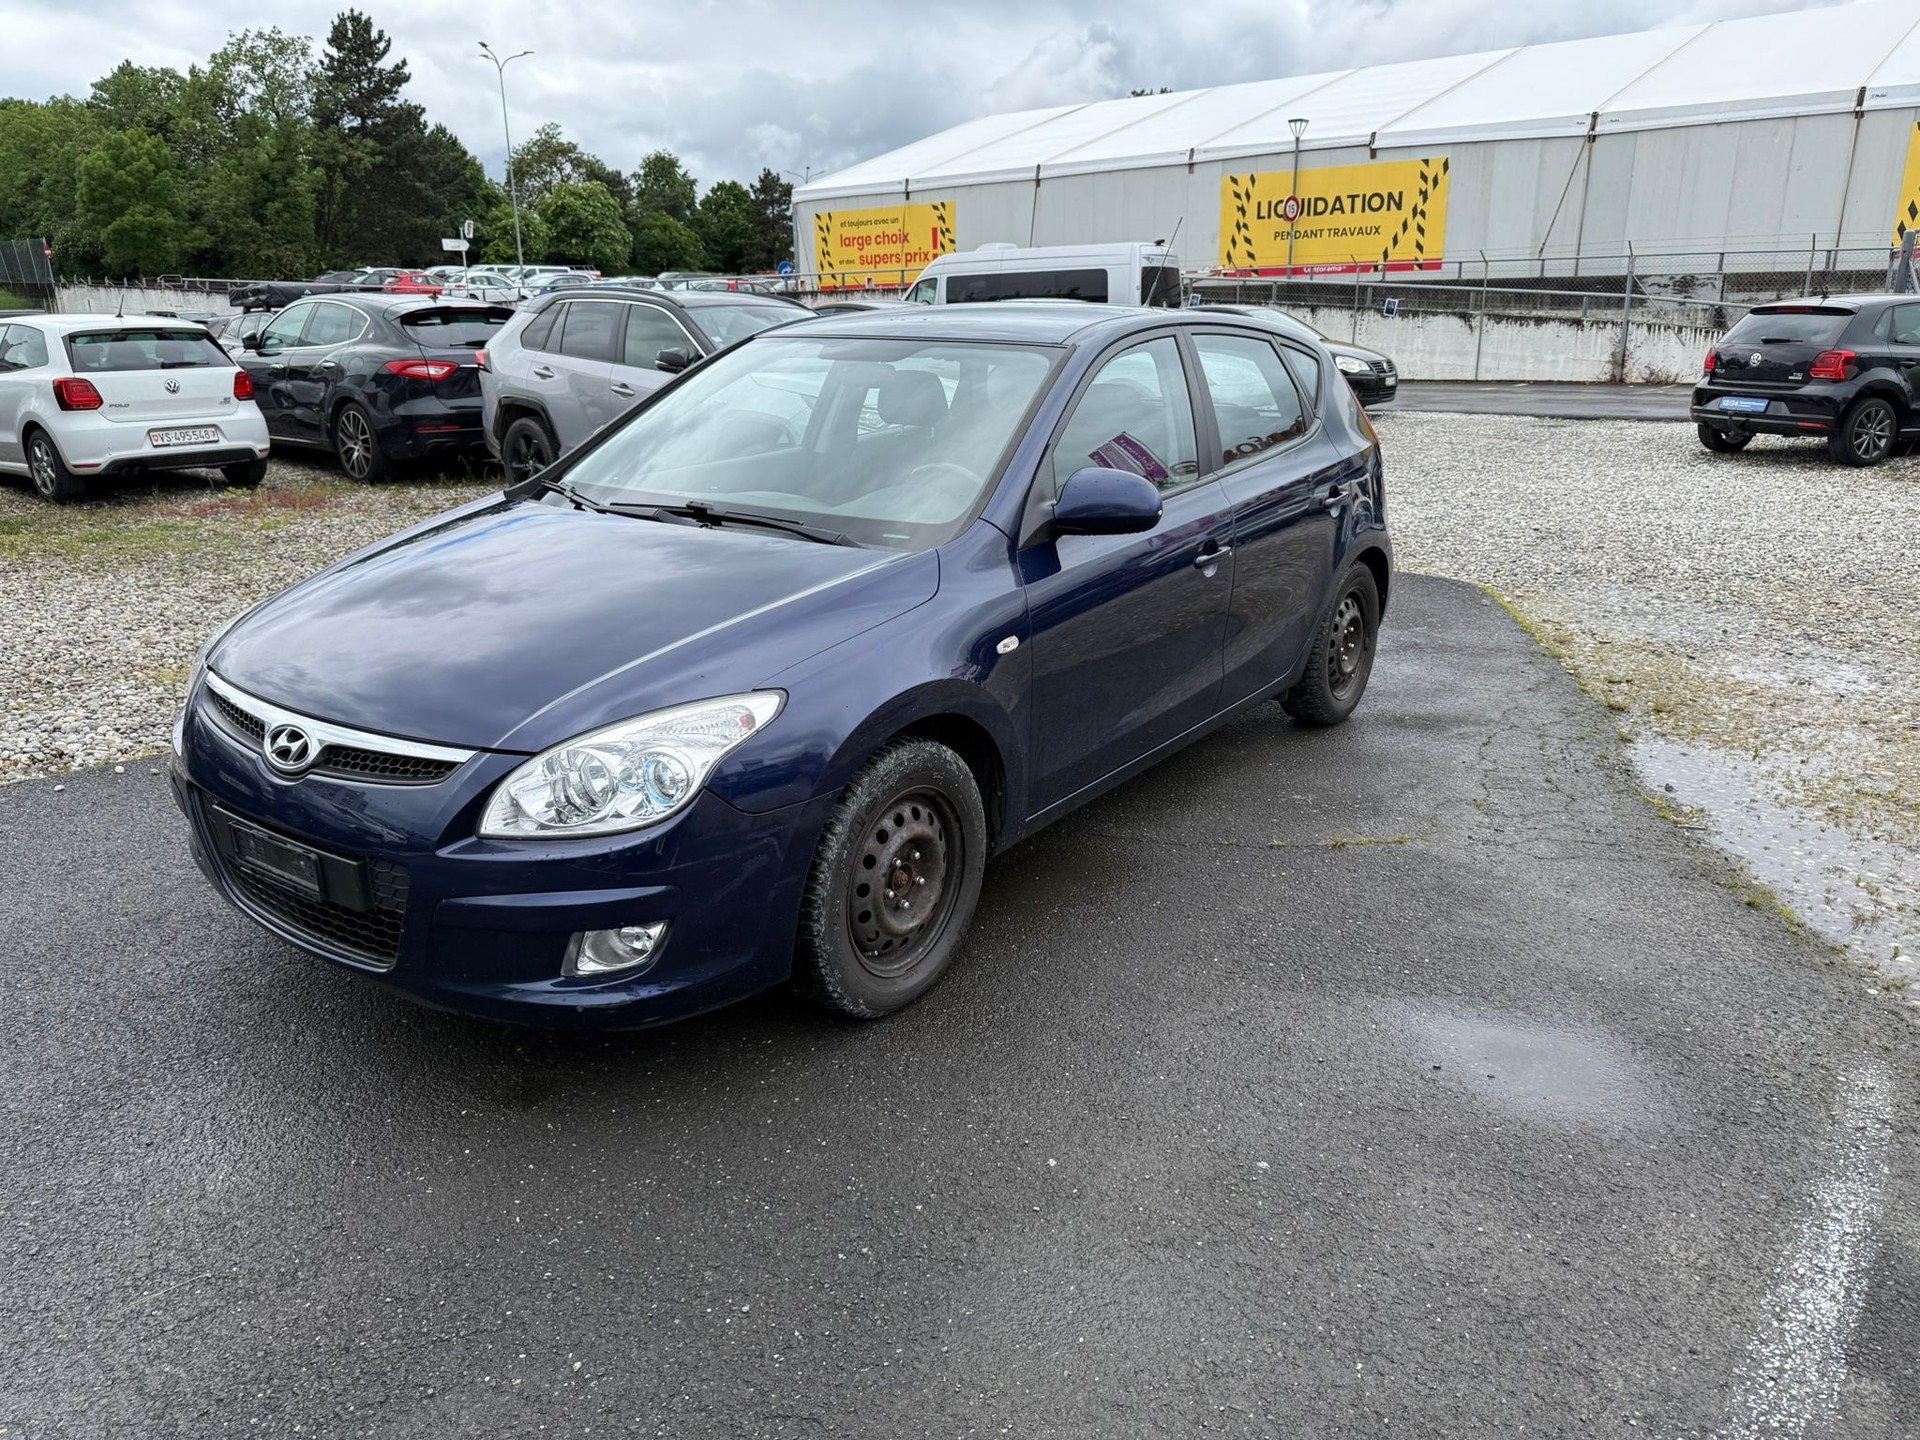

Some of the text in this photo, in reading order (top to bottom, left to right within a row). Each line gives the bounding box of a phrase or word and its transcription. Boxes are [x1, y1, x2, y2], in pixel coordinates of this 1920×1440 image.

[1288, 204, 1295, 214] 15
[847, 218, 873, 229] toujours
[840, 228, 910, 252] large choix
[1273, 225, 1381, 241] PENDANT TRAVAUX
[859, 252, 901, 269] supers
[904, 248, 930, 267] prix
